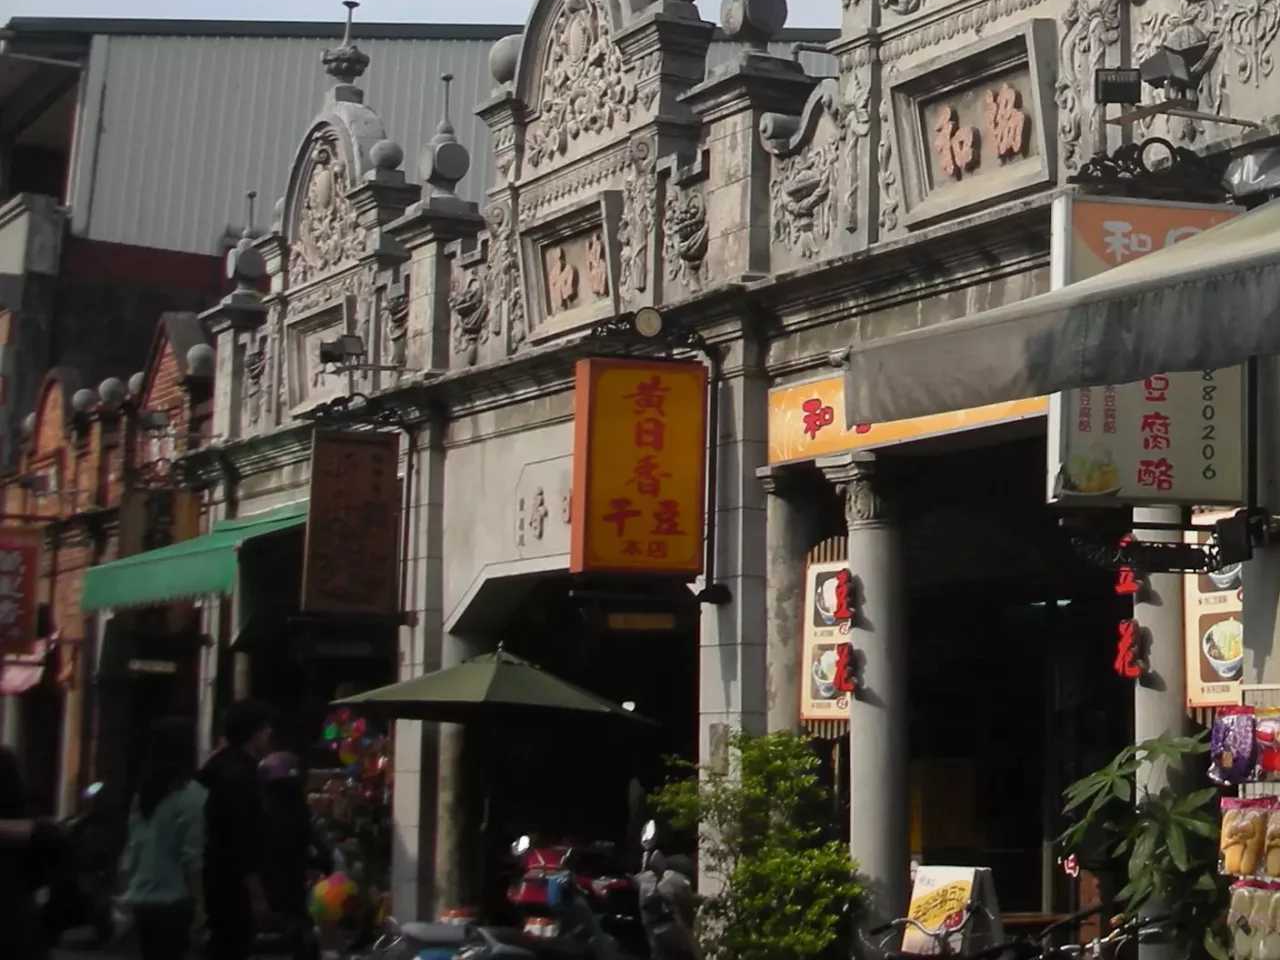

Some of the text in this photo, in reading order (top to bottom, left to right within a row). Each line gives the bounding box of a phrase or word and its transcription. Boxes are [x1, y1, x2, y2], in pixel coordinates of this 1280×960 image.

[621, 374, 673, 499] 黃日香
[1137, 372, 1174, 492] 豆腐酪
[621, 540, 669, 560] 本店
